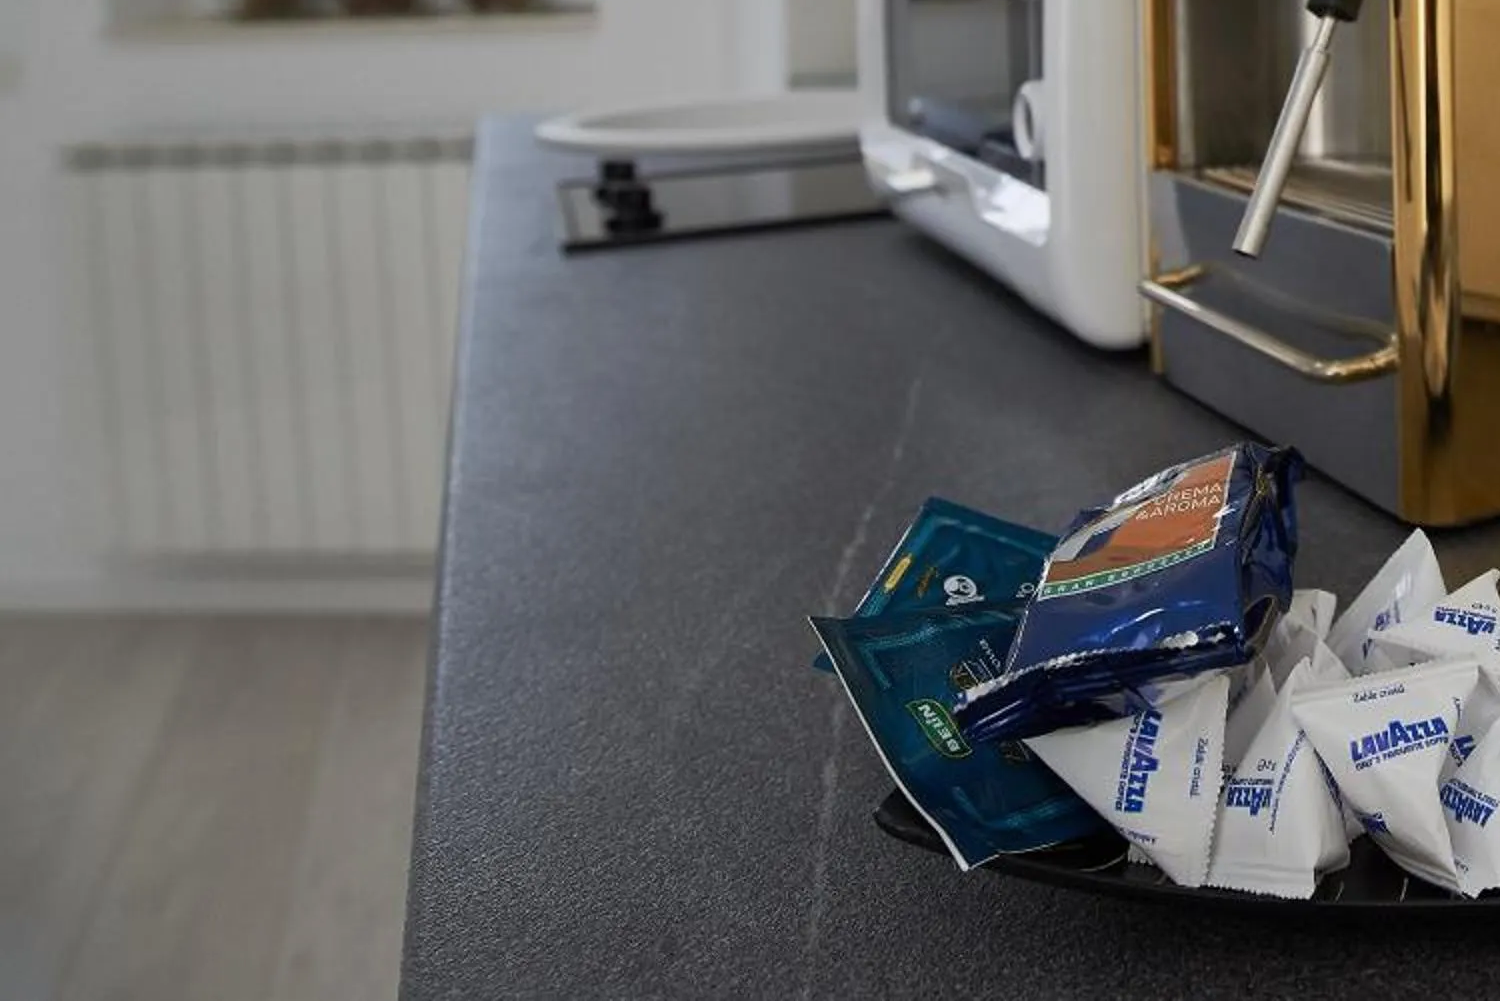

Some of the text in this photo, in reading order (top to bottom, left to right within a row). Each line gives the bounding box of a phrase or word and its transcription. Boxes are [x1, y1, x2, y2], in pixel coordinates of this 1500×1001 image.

[1122, 709, 1163, 814] LAVAZZA
[1350, 715, 1448, 763] LAVAZZA
[1226, 786, 1273, 818] VAZZA
